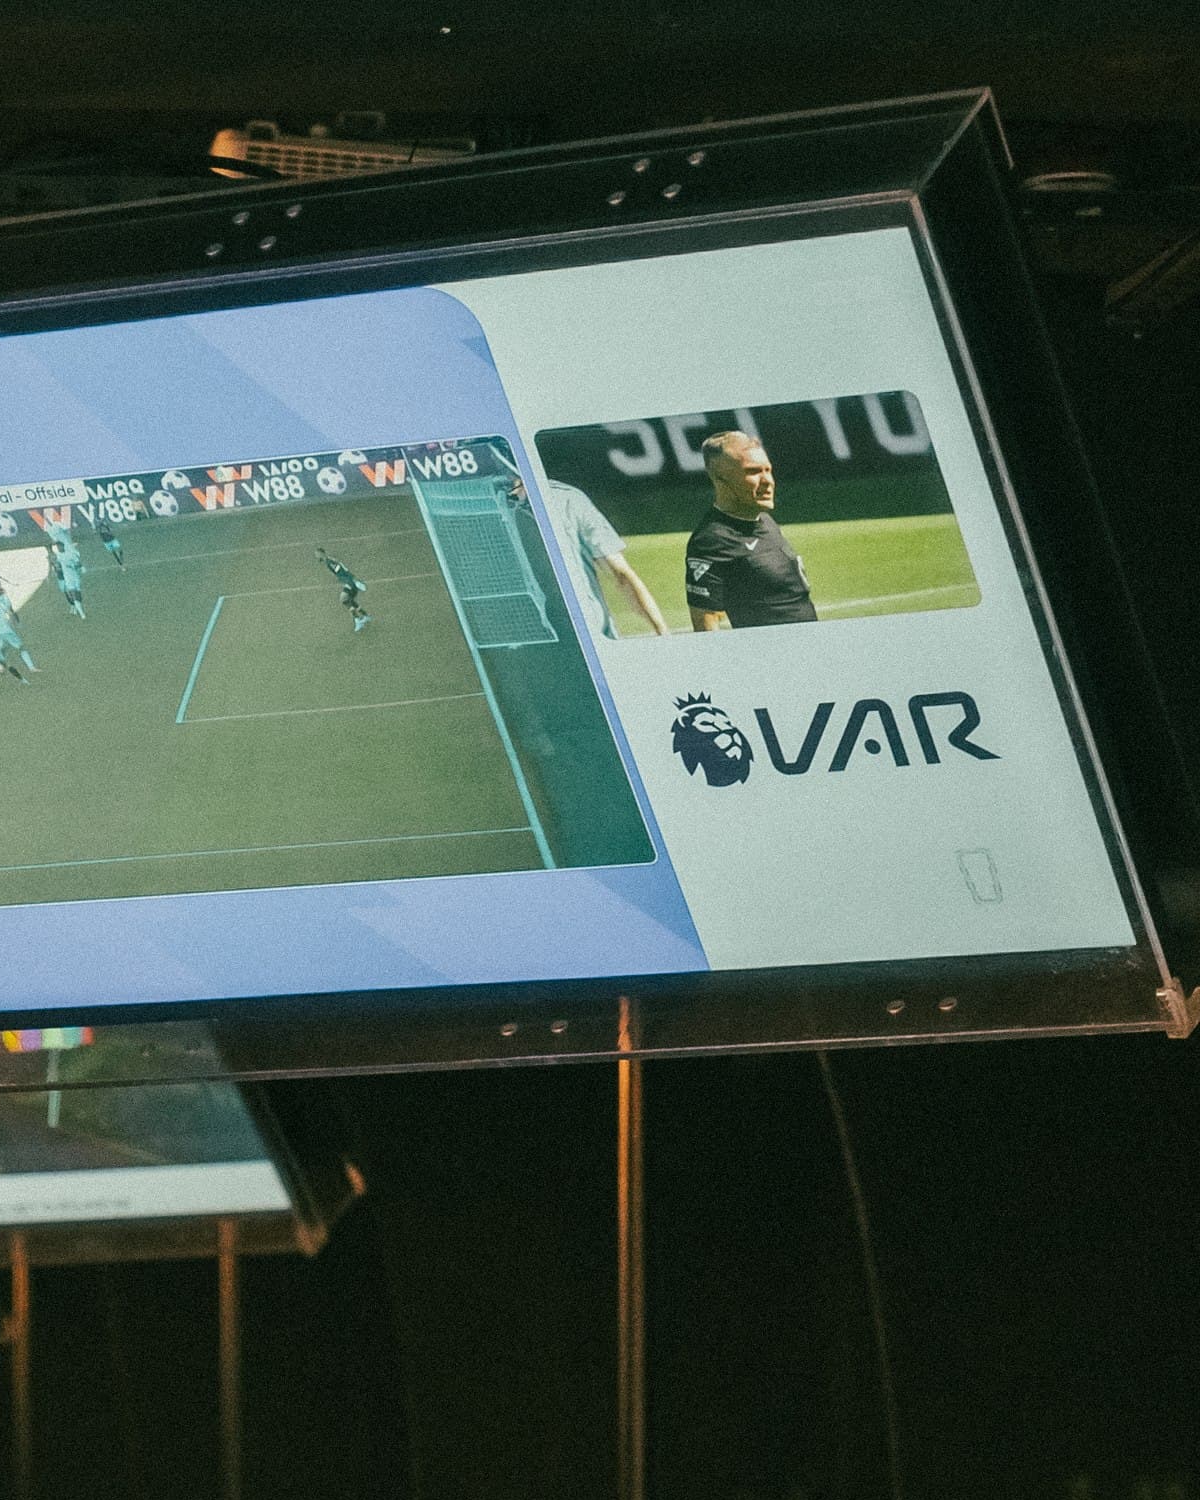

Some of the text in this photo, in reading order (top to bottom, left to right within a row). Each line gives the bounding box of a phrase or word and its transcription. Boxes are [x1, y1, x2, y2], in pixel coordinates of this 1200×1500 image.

[25, 485, 76, 501] Offside
[241, 473, 306, 504] W88
[413, 449, 479, 481] W88
[753, 690, 1003, 776] VAR
